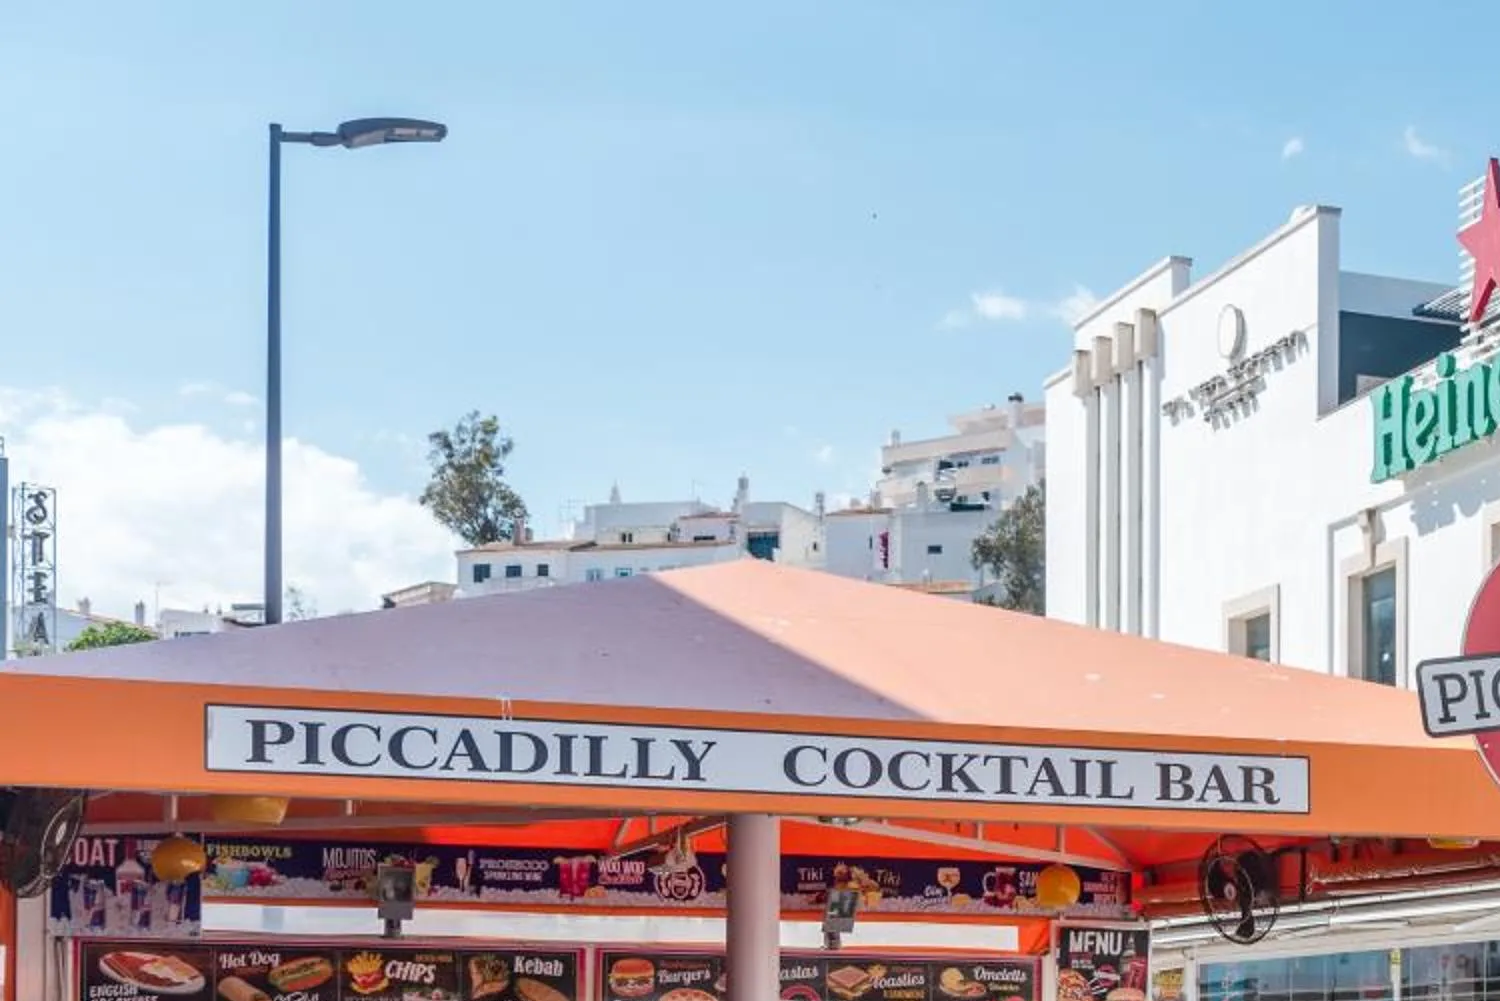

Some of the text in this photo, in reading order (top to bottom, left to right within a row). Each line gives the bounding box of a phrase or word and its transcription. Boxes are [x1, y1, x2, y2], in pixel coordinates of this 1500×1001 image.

[25, 490, 51, 656] STEA
[245, 719, 1280, 805] PICCADILLY COCKTAIL BAR
[66, 837, 119, 867] OAT
[206, 843, 293, 859] FISHBOWLS
[323, 848, 377, 868] MOJITOS
[798, 867, 824, 881] Tiki
[1069, 930, 1122, 955] MENU
[219, 951, 280, 969] Hot Dog
[514, 956, 563, 977] Kebab
[385, 960, 436, 984] CHIPS
[657, 969, 711, 986] Burgers
[778, 965, 819, 981] astas
[871, 973, 925, 988] Toasties
[90, 985, 138, 998] ENGLISH
